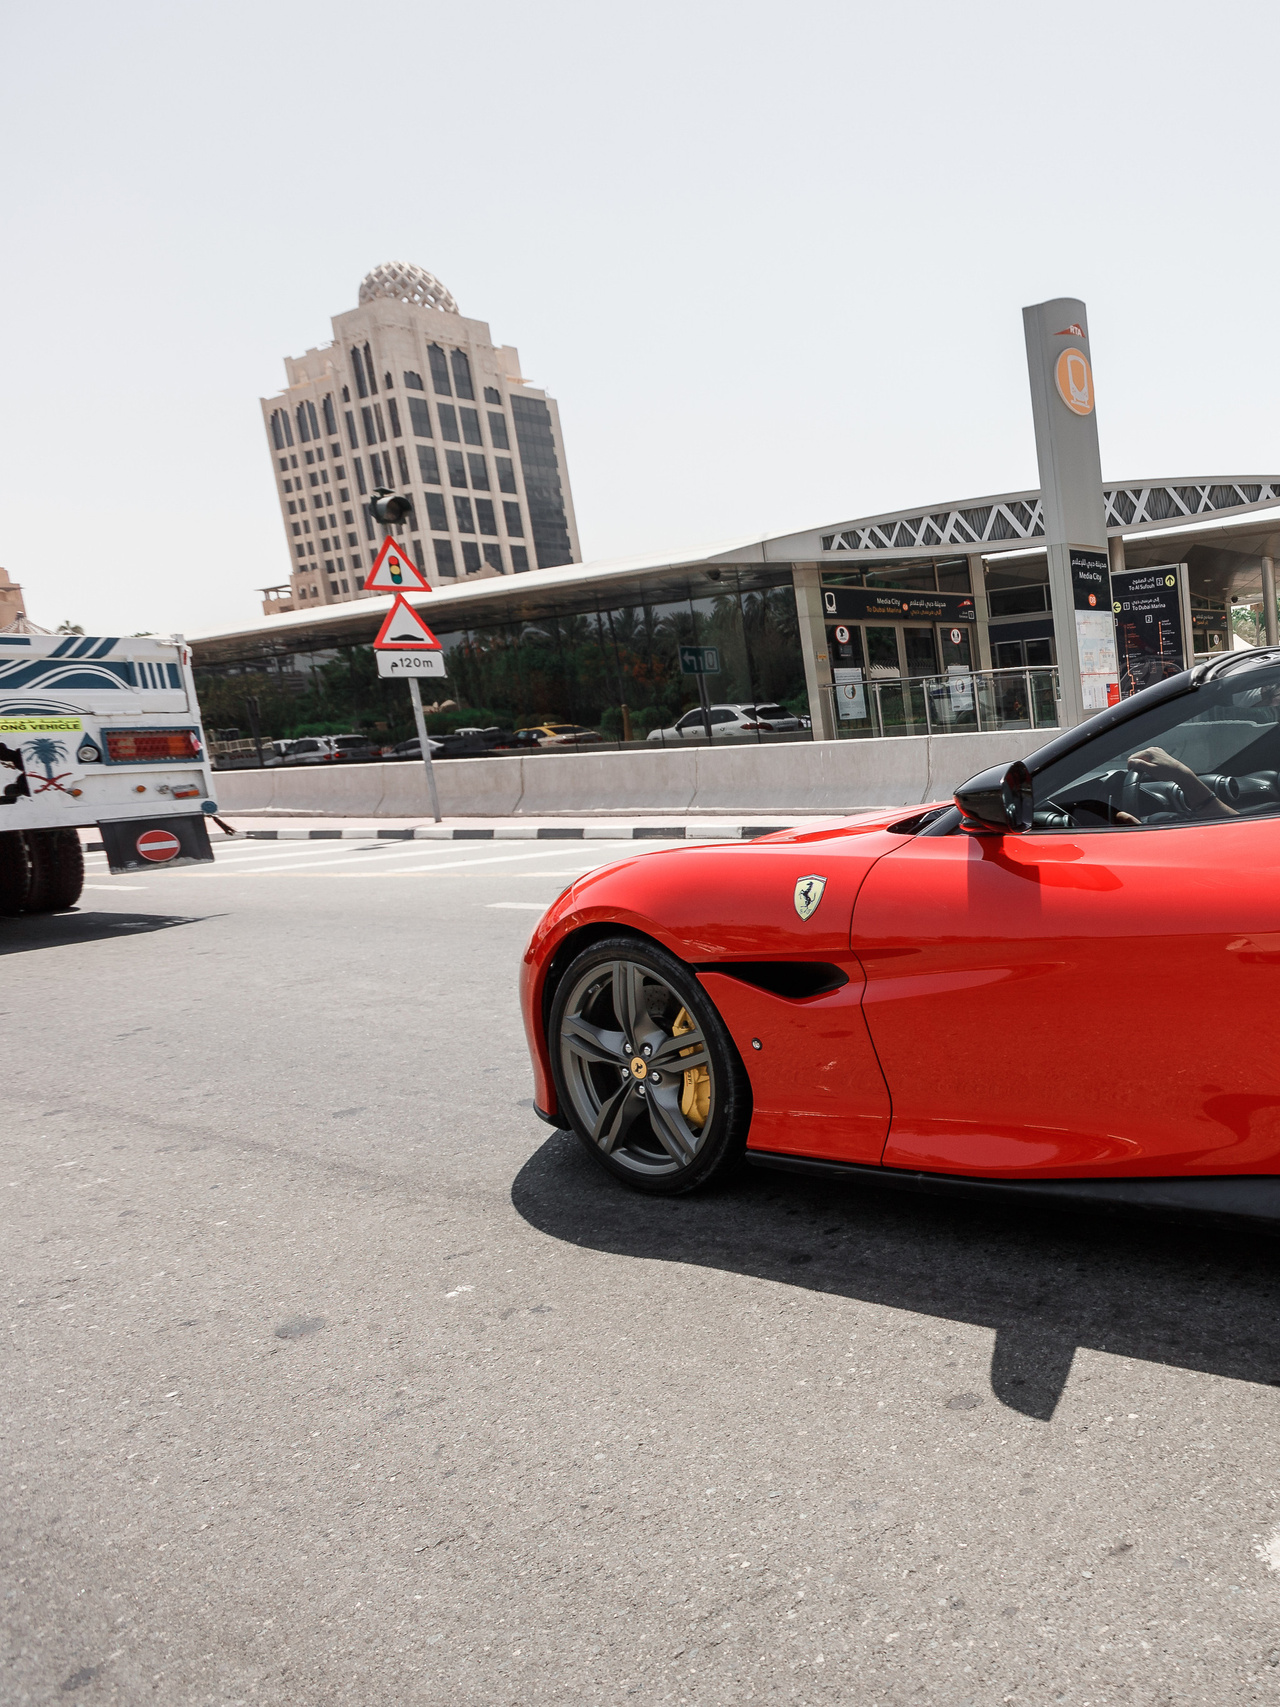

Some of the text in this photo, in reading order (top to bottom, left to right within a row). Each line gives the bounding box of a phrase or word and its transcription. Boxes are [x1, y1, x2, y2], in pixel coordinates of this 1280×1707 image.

[1070, 325, 1081, 336] RTA
[1079, 571, 1102, 583] Media City
[30, 723, 81, 731] VEHICLE
